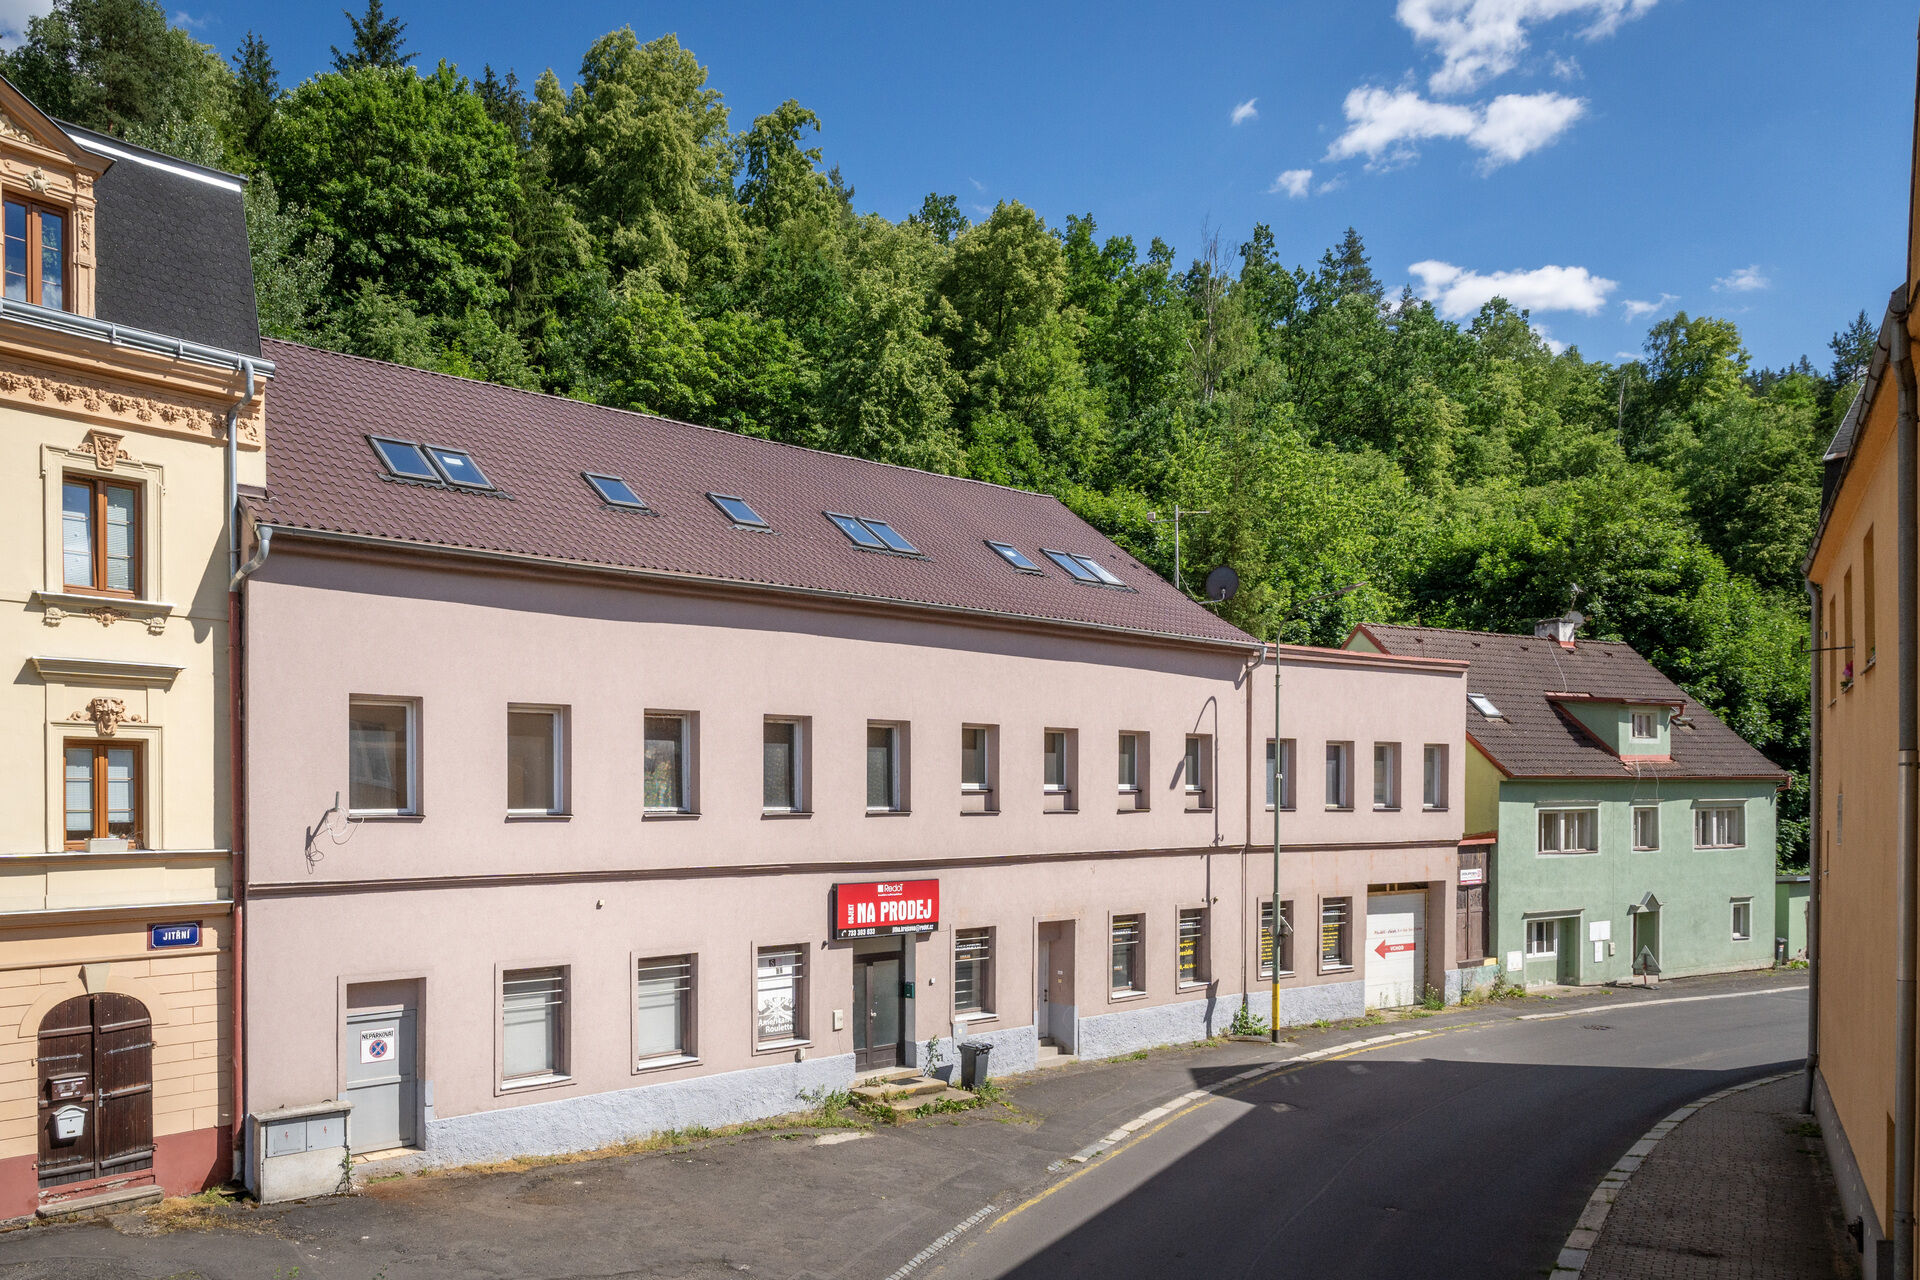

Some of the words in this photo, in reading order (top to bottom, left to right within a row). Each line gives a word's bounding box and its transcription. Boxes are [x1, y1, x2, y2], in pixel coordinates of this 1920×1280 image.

[857, 902, 876, 923] NA
[880, 899, 932, 922] PRODEJ
[162, 928, 191, 941] JITŘNÍ
[765, 1024, 794, 1034] Roulette
[361, 1031, 394, 1040] NEPARKOVAT
